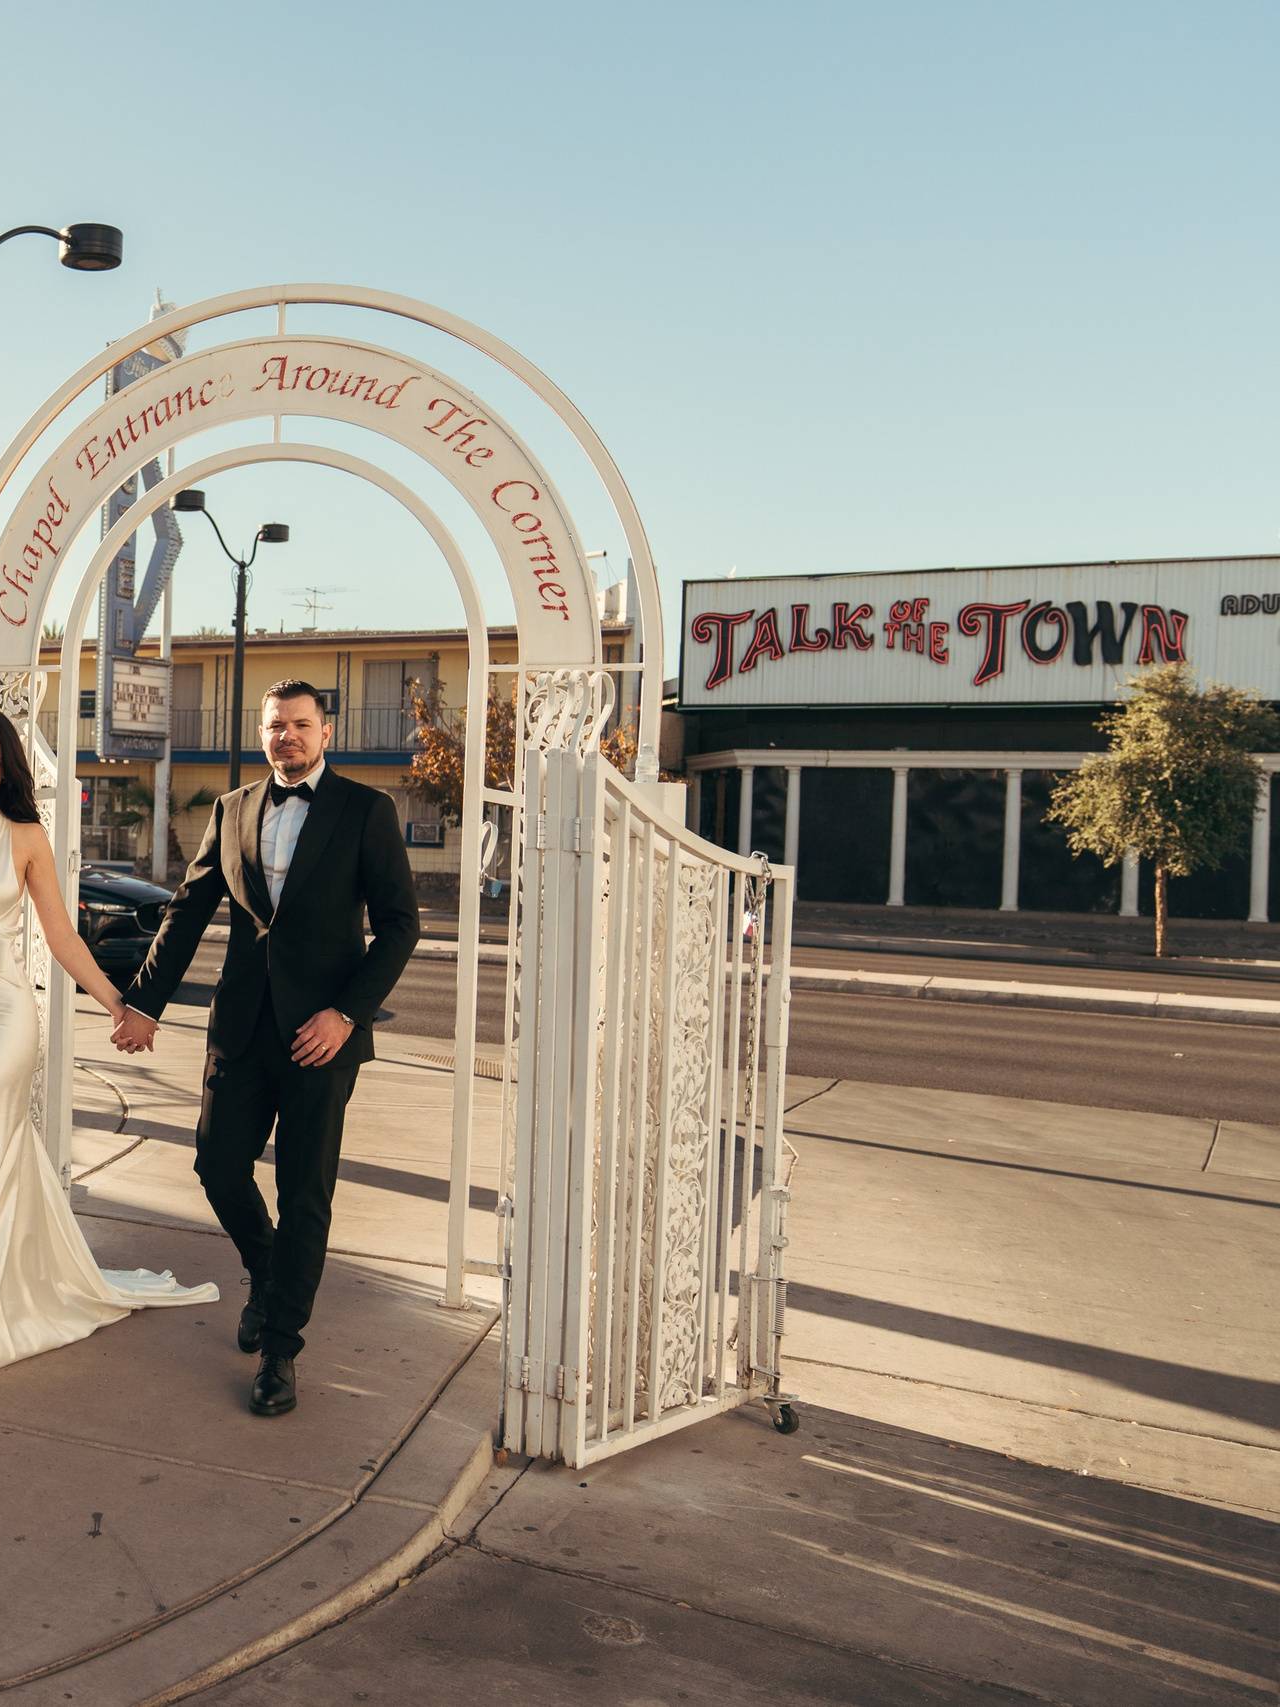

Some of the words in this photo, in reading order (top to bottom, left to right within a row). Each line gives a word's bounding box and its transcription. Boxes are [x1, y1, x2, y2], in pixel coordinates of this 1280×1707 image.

[251, 355, 422, 409] Around
[423, 398, 494, 468] The
[491, 479, 570, 621] Corner
[692, 602, 874, 690] TALK
[883, 622, 949, 664] THE
[889, 598, 930, 623] OF
[958, 599, 1189, 686] TOWN
